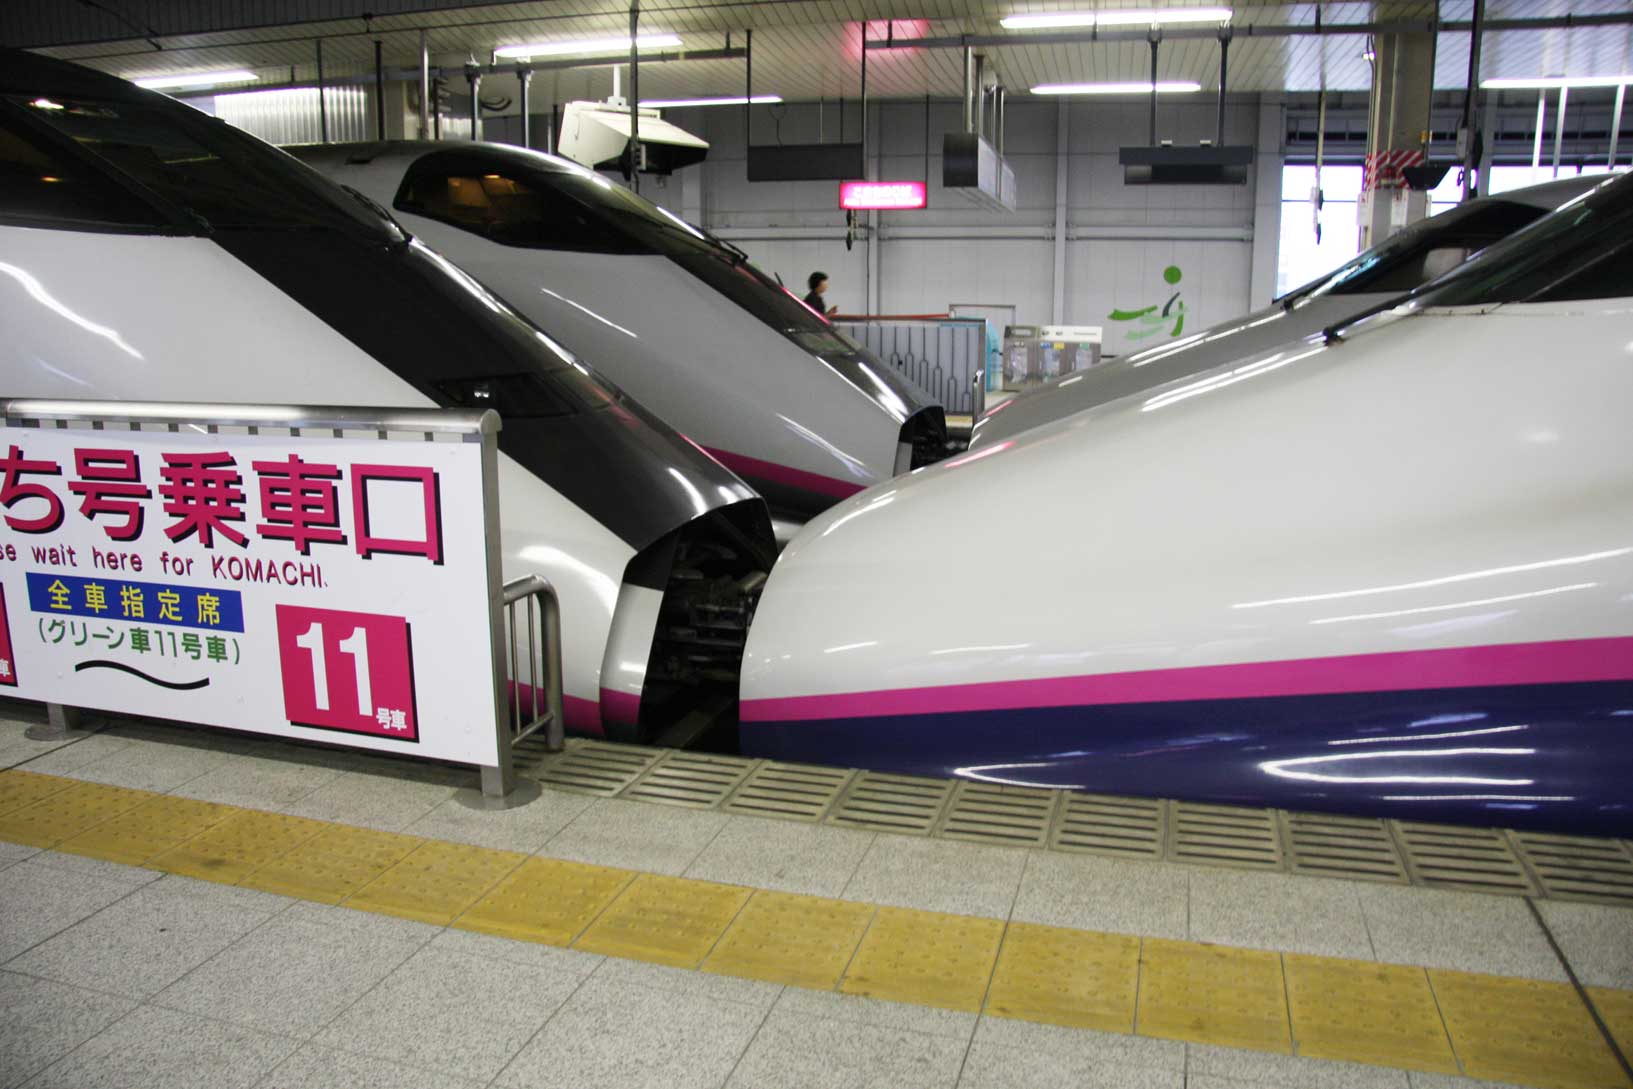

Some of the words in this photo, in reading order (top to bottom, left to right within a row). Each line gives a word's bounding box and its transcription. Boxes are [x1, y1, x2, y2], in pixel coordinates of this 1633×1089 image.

[0, 444, 444, 565] ち号乗車口
[31, 543, 78, 568] wait
[92, 545, 143, 572] here
[160, 551, 194, 577] for
[47, 579, 221, 626] 全車指定席
[296, 621, 373, 717] 11
[376, 706, 408, 731] 号車
